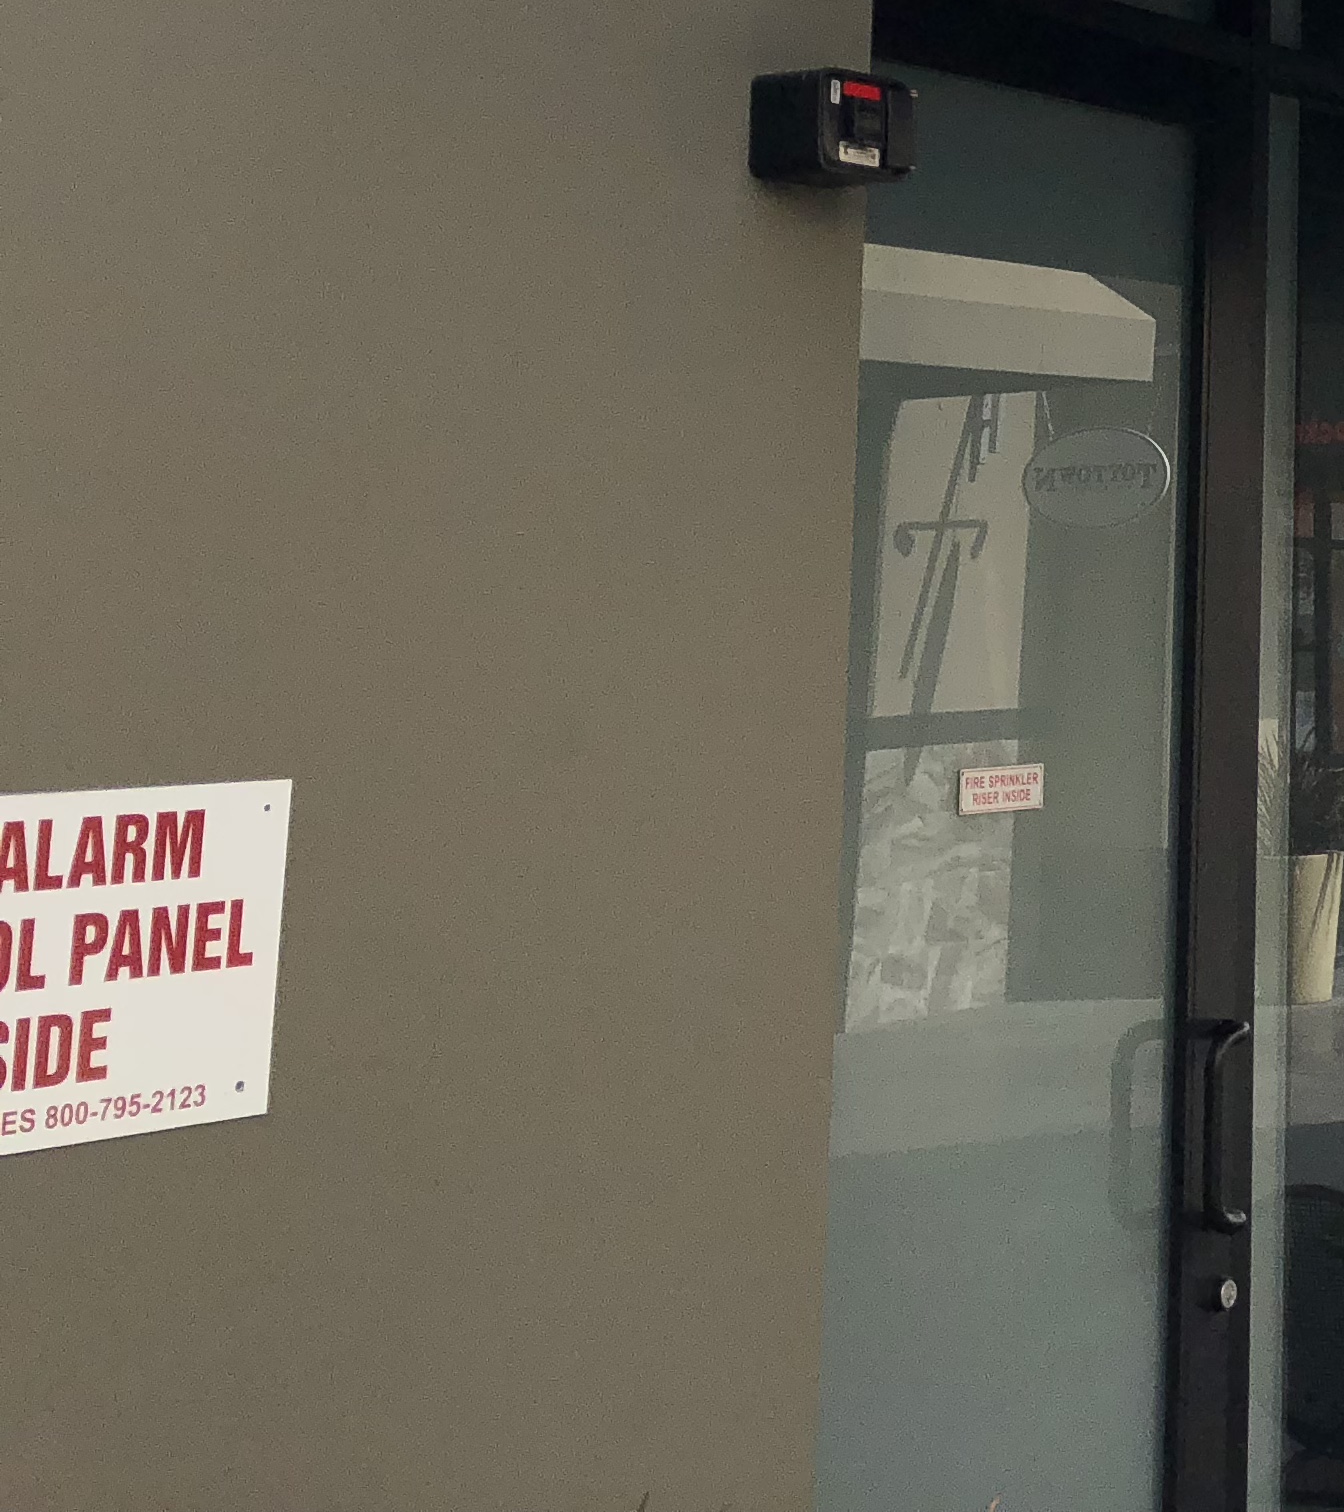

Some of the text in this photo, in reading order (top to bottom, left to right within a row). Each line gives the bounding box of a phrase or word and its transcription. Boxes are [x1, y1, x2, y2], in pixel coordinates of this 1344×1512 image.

[965, 772, 1039, 790] FIRE SPRINKLER
[972, 789, 1032, 806] RISER INSIDE
[0, 809, 206, 892] ALARM
[68, 899, 254, 987] PANEL
[45, 1085, 207, 1130] 800-795-2123
